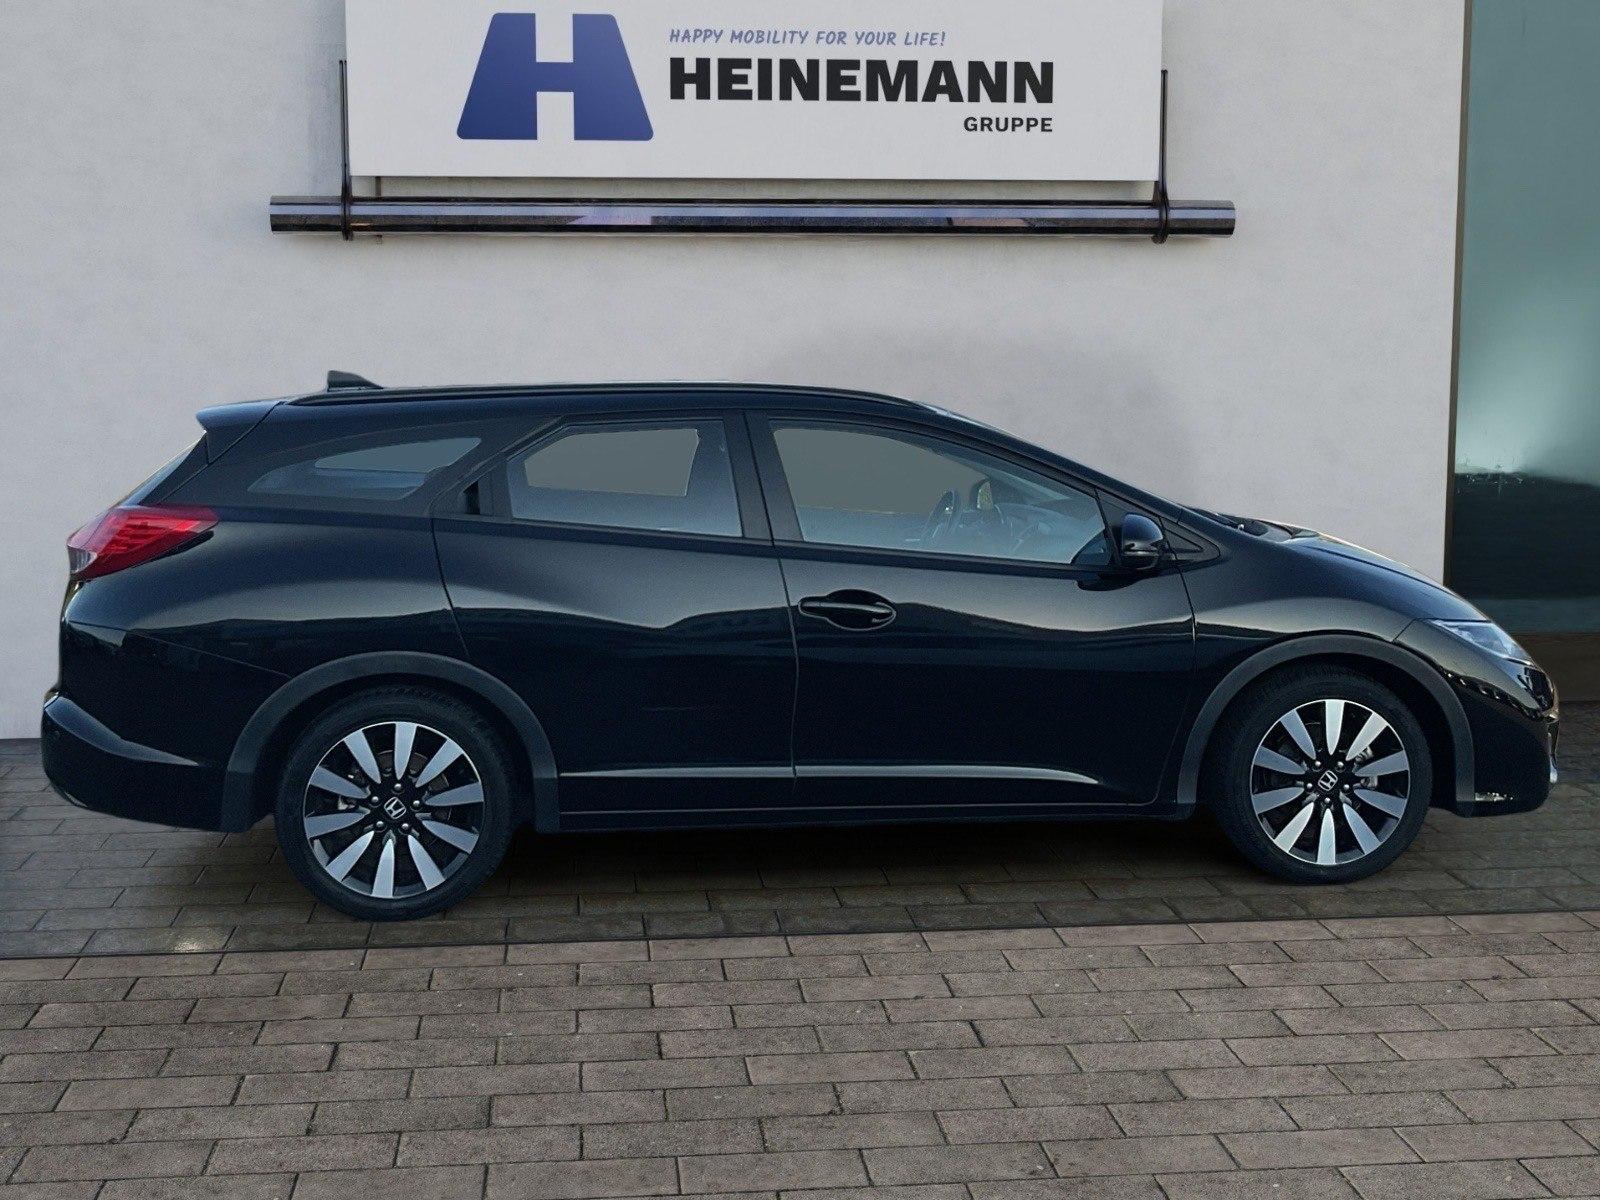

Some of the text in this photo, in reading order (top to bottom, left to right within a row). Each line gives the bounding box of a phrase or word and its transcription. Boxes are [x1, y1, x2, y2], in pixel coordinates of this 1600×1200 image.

[669, 28, 947, 47] HAPPY MOBILITY FOR YOUR LIFE!
[456, 12, 654, 142] H
[669, 57, 1054, 104] HEINEMANN
[963, 116, 1053, 133] GRUPPE
